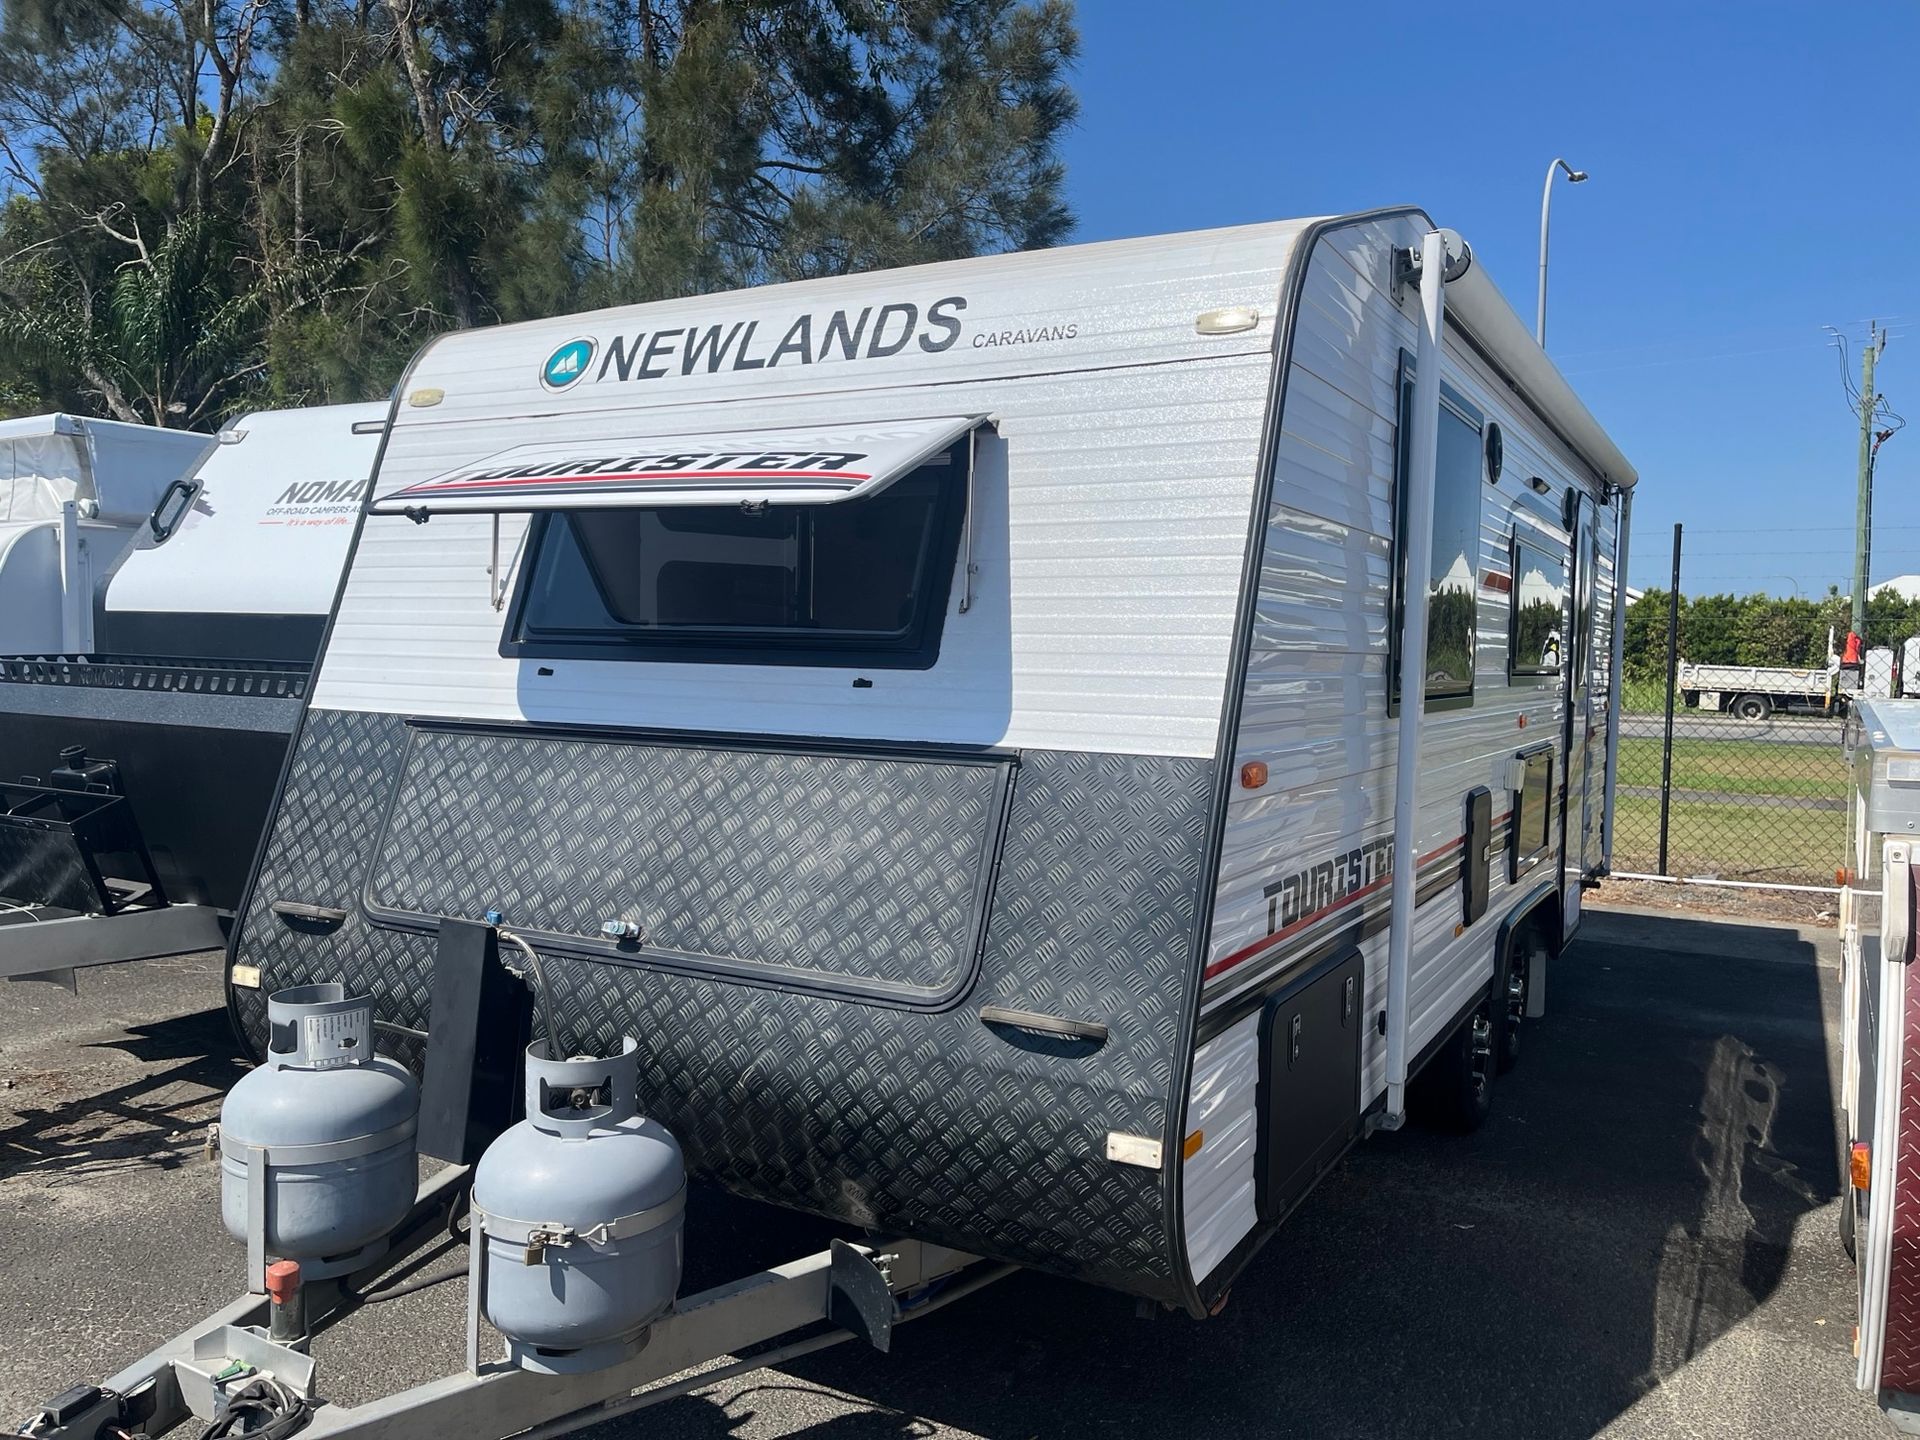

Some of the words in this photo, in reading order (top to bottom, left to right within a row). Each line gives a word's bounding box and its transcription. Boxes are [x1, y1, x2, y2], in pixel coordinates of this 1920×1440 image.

[596, 296, 967, 382] NEWLANDS
[973, 324, 1079, 348] CARAVANS
[436, 449, 869, 484] TOURISTER
[274, 479, 368, 504] NOMA
[266, 506, 309, 516] OFF-ROAD
[309, 505, 350, 515] CAMPERS
